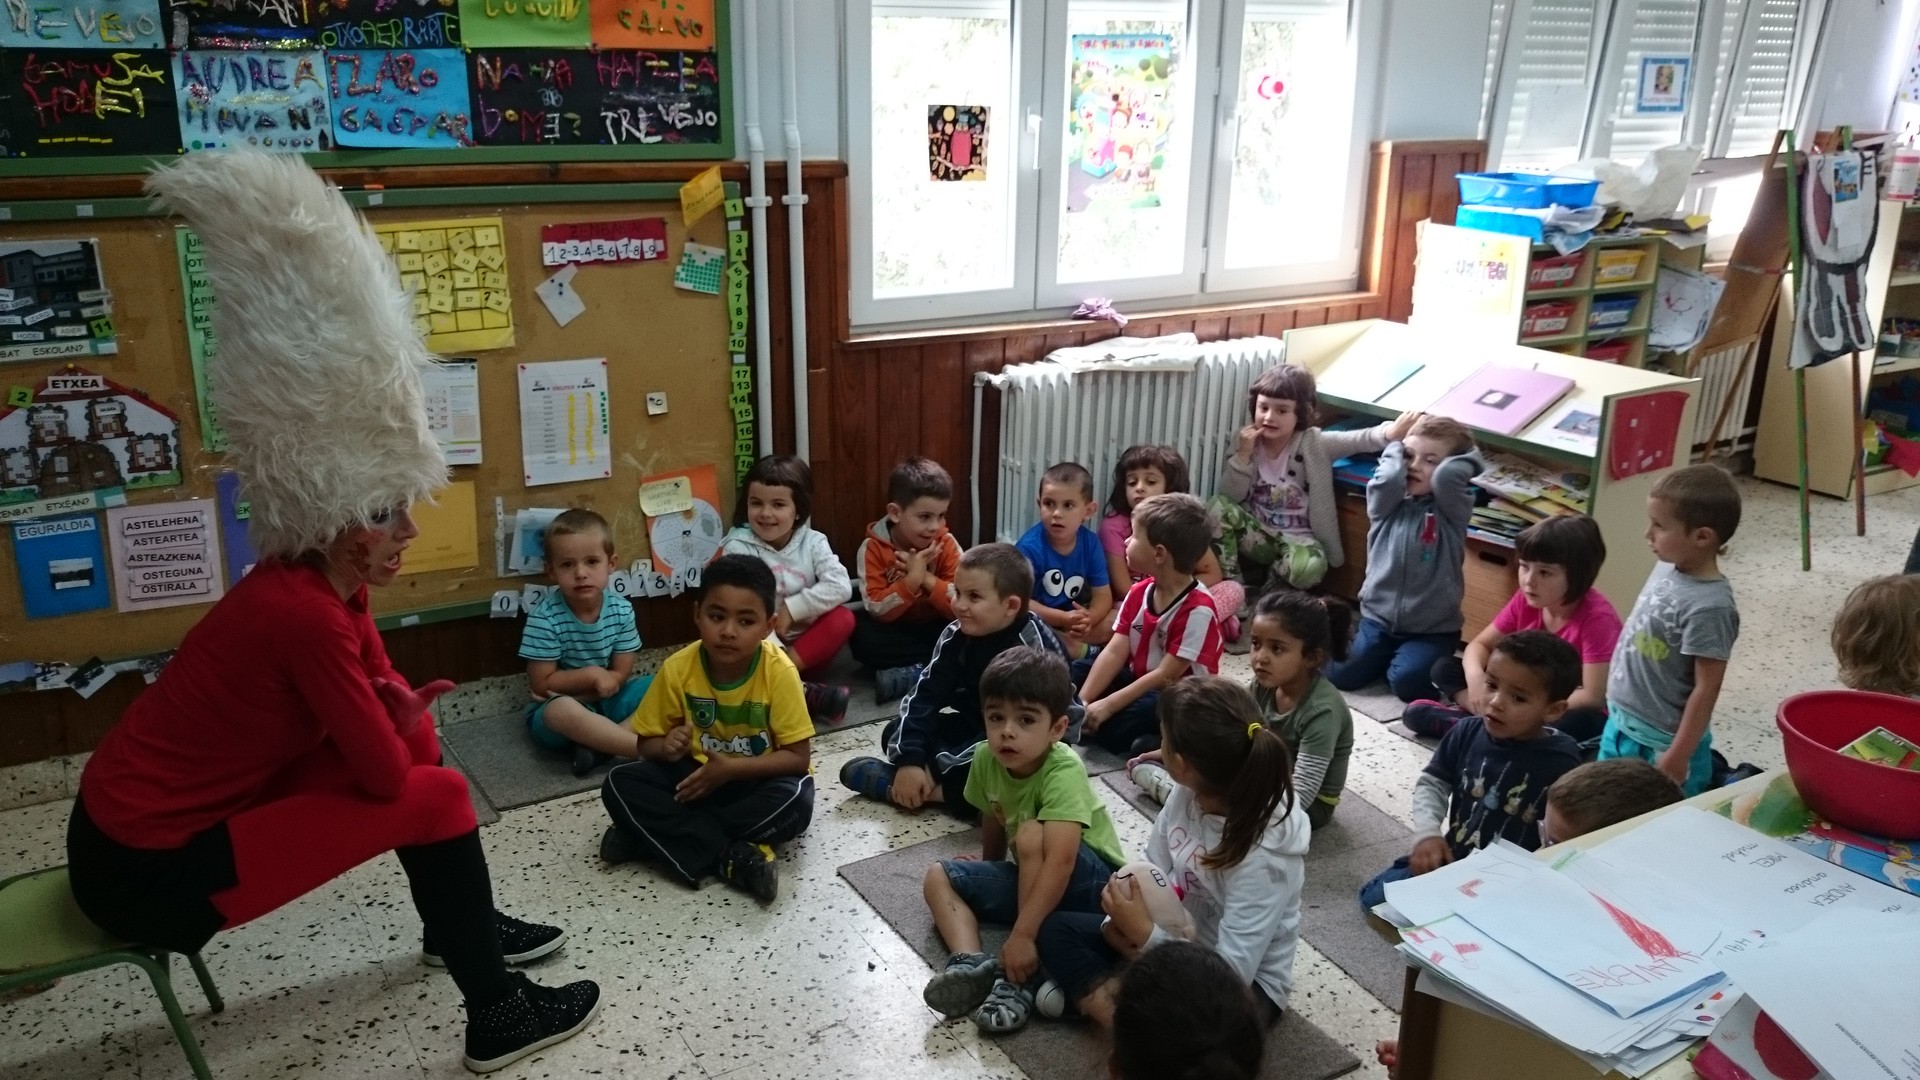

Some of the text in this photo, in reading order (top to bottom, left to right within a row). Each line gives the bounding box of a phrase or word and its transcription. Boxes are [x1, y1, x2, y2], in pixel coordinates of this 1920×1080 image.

[732, 203, 737, 212] 1
[736, 234, 742, 243] 3
[736, 248, 742, 257] 4
[734, 267, 742, 276] 5
[735, 294, 742, 302] 7
[736, 307, 742, 316] 8
[94, 320, 112, 333] 11
[736, 321, 743, 330] 9
[731, 339, 744, 348] 10
[33, 344, 84, 356] ESKOLAN?
[51, 379, 99, 389] ETXEA
[737, 382, 750, 390] 13
[17, 391, 27, 402] 2
[733, 395, 746, 404] 14
[738, 409, 751, 418] 15
[739, 426, 752, 436] 16
[738, 444, 751, 452] 19
[125, 514, 199, 531] ASTELEHENA
[19, 519, 91, 538] EGURALDIA
[132, 532, 198, 547] ASTEARTEA
[128, 552, 202, 563] ASTEAZKENA
[142, 566, 204, 581] OSTEGUNA
[141, 581, 197, 594] OSTIRALA
[614, 577, 625, 593] 6
